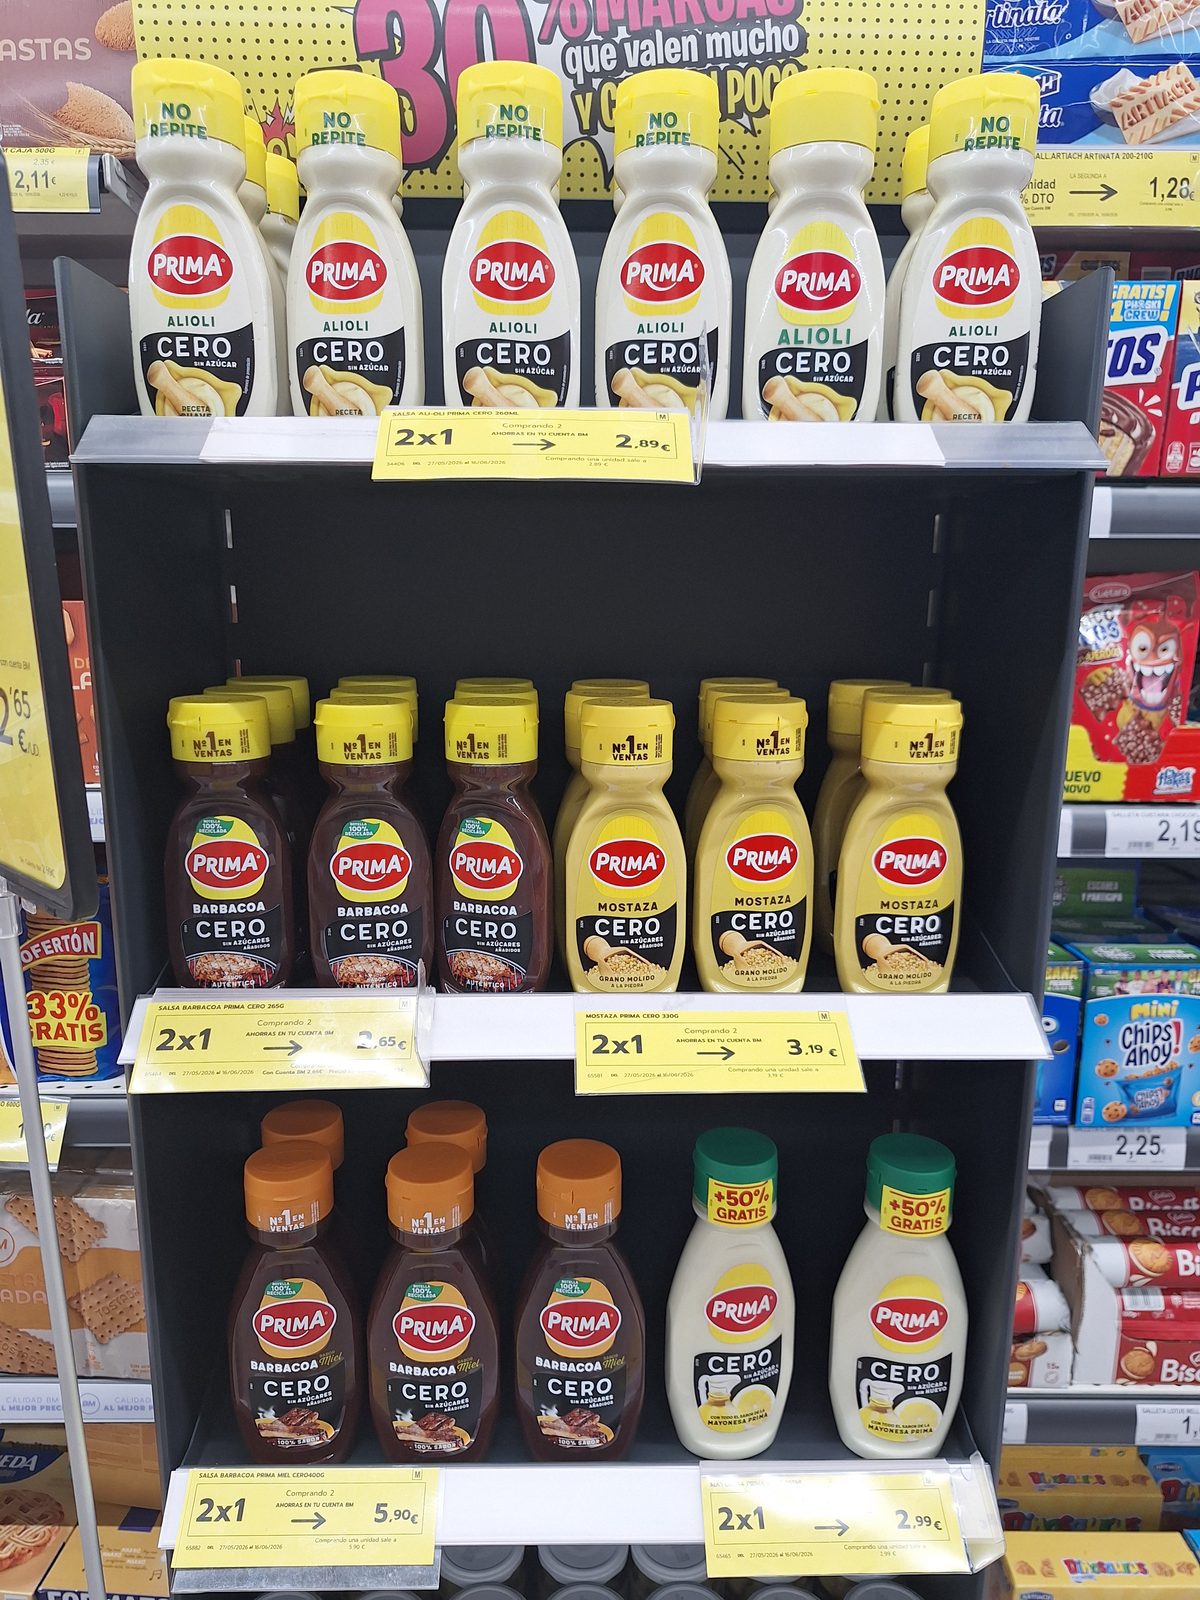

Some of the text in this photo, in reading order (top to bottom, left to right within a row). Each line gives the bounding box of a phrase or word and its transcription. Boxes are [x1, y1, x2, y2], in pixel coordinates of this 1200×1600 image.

[566, 19, 799, 84] que valen mucho
[162, 102, 191, 120] NO
[323, 111, 352, 129] NO
[500, 105, 528, 122] NO
[650, 112, 677, 128] NO
[150, 122, 207, 140] REPITE
[486, 124, 541, 141] REPITE
[980, 116, 1009, 132] NO
[312, 131, 366, 147] REPITE
[636, 131, 691, 148] REPITE
[964, 136, 1020, 152] REPITE
[1032, 194, 1054, 204] DTO
[153, 254, 223, 284] PRIMA
[311, 261, 377, 290] PRIMA
[476, 259, 546, 291] PRIMA
[626, 260, 694, 291] PRIMA
[781, 269, 851, 300] PRIMA
[939, 264, 1010, 294] PRIMA
[167, 316, 215, 327] ALIOLI
[1125, 310, 1159, 320] CREW
[323, 321, 368, 332] ALIOLI
[489, 322, 537, 333] ALIOLI
[637, 322, 684, 334] ALIOLI
[949, 326, 997, 336] ALIOLI
[778, 328, 851, 345] ALIOLI
[157, 337, 231, 358] CERO
[313, 341, 384, 362] CERO
[477, 343, 551, 365] CERO
[624, 343, 697, 365] CERO
[934, 346, 1009, 367] CERO
[206, 359, 237, 368] AZÚCAR
[776, 352, 850, 373] CERO
[395, 428, 453, 446] 2x1
[194, 749, 232, 757] VENTAS
[344, 752, 381, 760] VENTAS
[193, 853, 258, 880] PRIMA
[338, 855, 402, 882] PRIMA
[455, 853, 513, 881] PRIMA
[596, 852, 657, 878] PRIMA
[733, 846, 791, 874] PRIMA
[879, 850, 942, 877] PRIMA
[193, 902, 265, 914] BARBACOA
[338, 903, 408, 917] BARBACOA
[454, 901, 517, 916] BARBACOA
[598, 902, 658, 912] MOSTAZA
[735, 895, 791, 906] MOSTAZA
[880, 900, 938, 910] MOSTAZA
[196, 919, 265, 939] CERO
[455, 918, 516, 939] CERO
[595, 918, 660, 936] CERO
[731, 911, 793, 930] CERO
[875, 916, 940, 934] CERO
[341, 921, 408, 941] CERO
[19, 927, 95, 964] OFERTÓN
[233, 937, 270, 946] AZÚCARES
[156, 1028, 211, 1051] 2x1
[592, 1034, 642, 1054] 2x1
[1116, 1134, 1161, 1159] 2,25
[714, 1186, 770, 1208] +50%
[716, 1205, 767, 1222] GRATIS
[889, 1199, 946, 1218] +50%
[891, 1214, 944, 1232] GRATIS
[712, 1295, 770, 1324] PRIMA
[261, 1310, 325, 1339] PRIMA
[400, 1315, 464, 1343] PRIMA
[548, 1312, 610, 1339] PRIMA
[876, 1306, 939, 1335] PRIMA
[251, 1352, 343, 1373] BARBACOA Miel
[390, 1359, 481, 1376] BARBACOA Miel
[535, 1355, 625, 1373] BARBACOA Miel
[708, 1349, 772, 1373] CERO
[870, 1361, 940, 1383] CERO
[264, 1375, 329, 1397] CERO
[402, 1381, 467, 1401] CERO
[548, 1378, 611, 1397] CERO
[868, 1424, 909, 1434] MAYONESA
[196, 1498, 246, 1522] 2x1
[718, 1506, 765, 1531] 2x1
